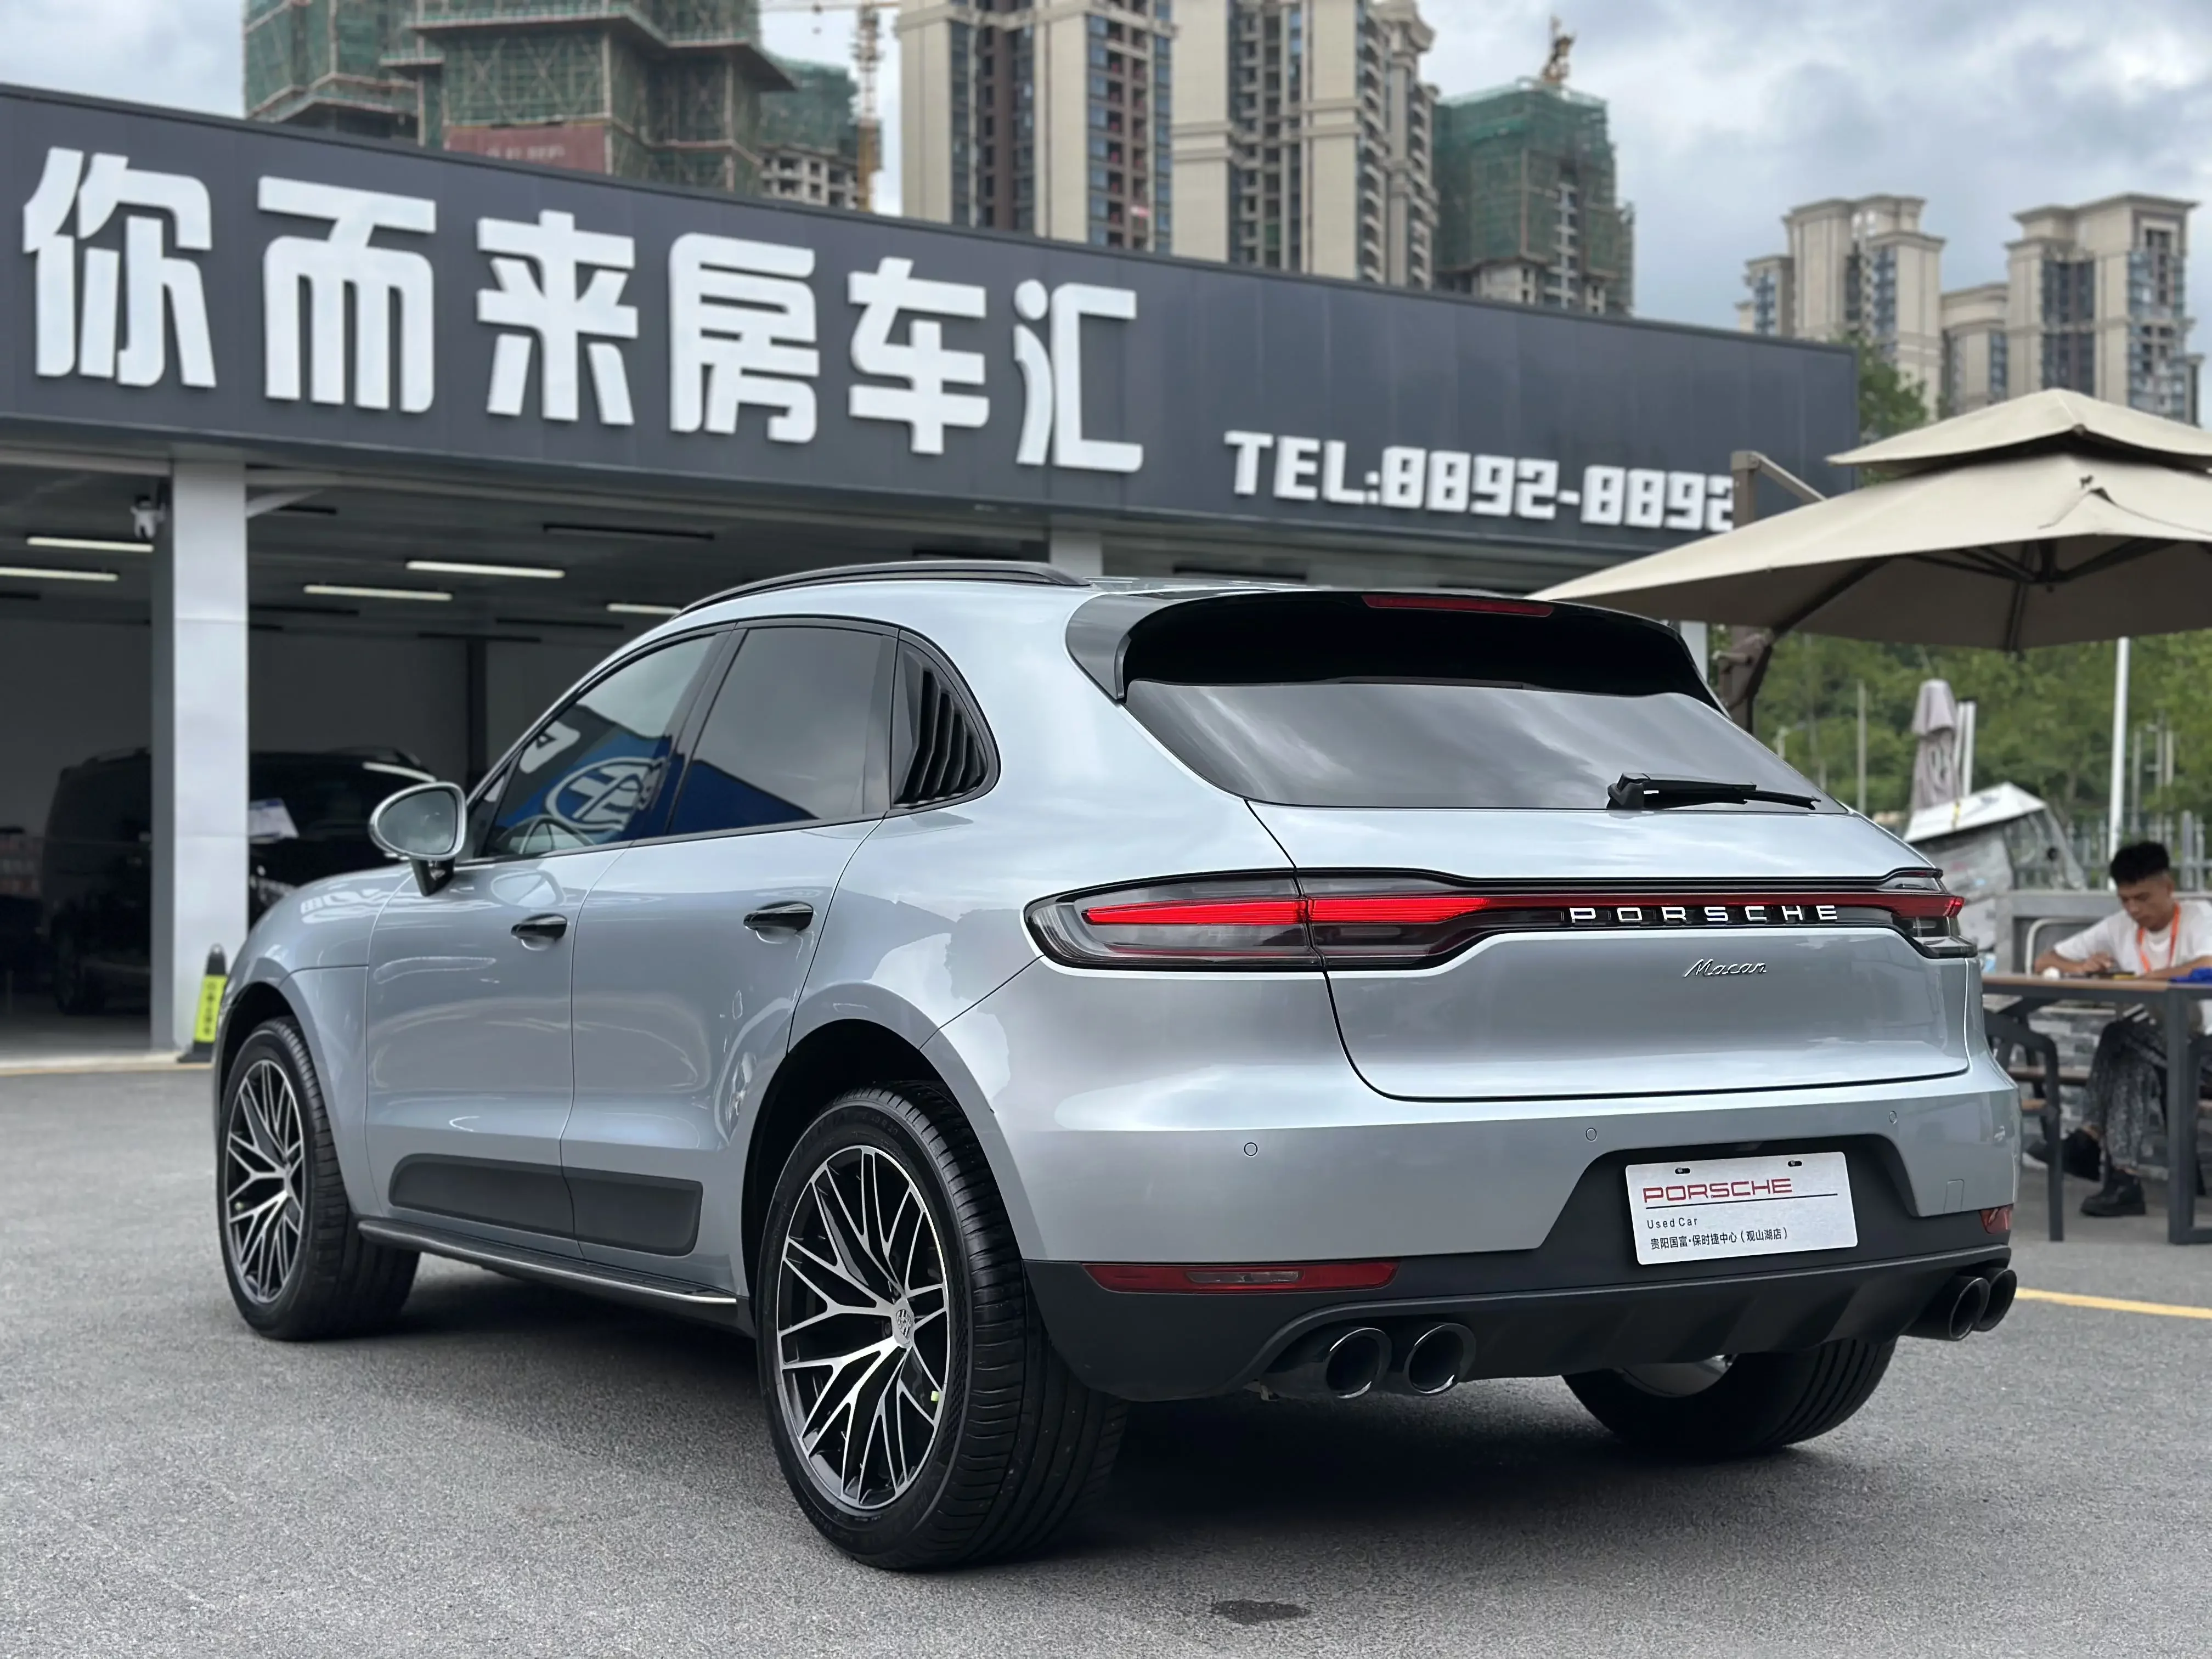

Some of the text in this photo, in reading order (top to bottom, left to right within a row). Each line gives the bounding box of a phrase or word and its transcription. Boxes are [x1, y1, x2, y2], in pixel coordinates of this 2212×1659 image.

[24, 148, 1143, 471] 你而来房车汇
[1224, 430, 1734, 532] TEL:8892-8892
[1569, 905, 1838, 923] PORSCHE
[1683, 958, 1767, 978] Macan
[1643, 1178, 1792, 1203] PORSCHE
[1647, 1217, 1697, 1229] Used Car
